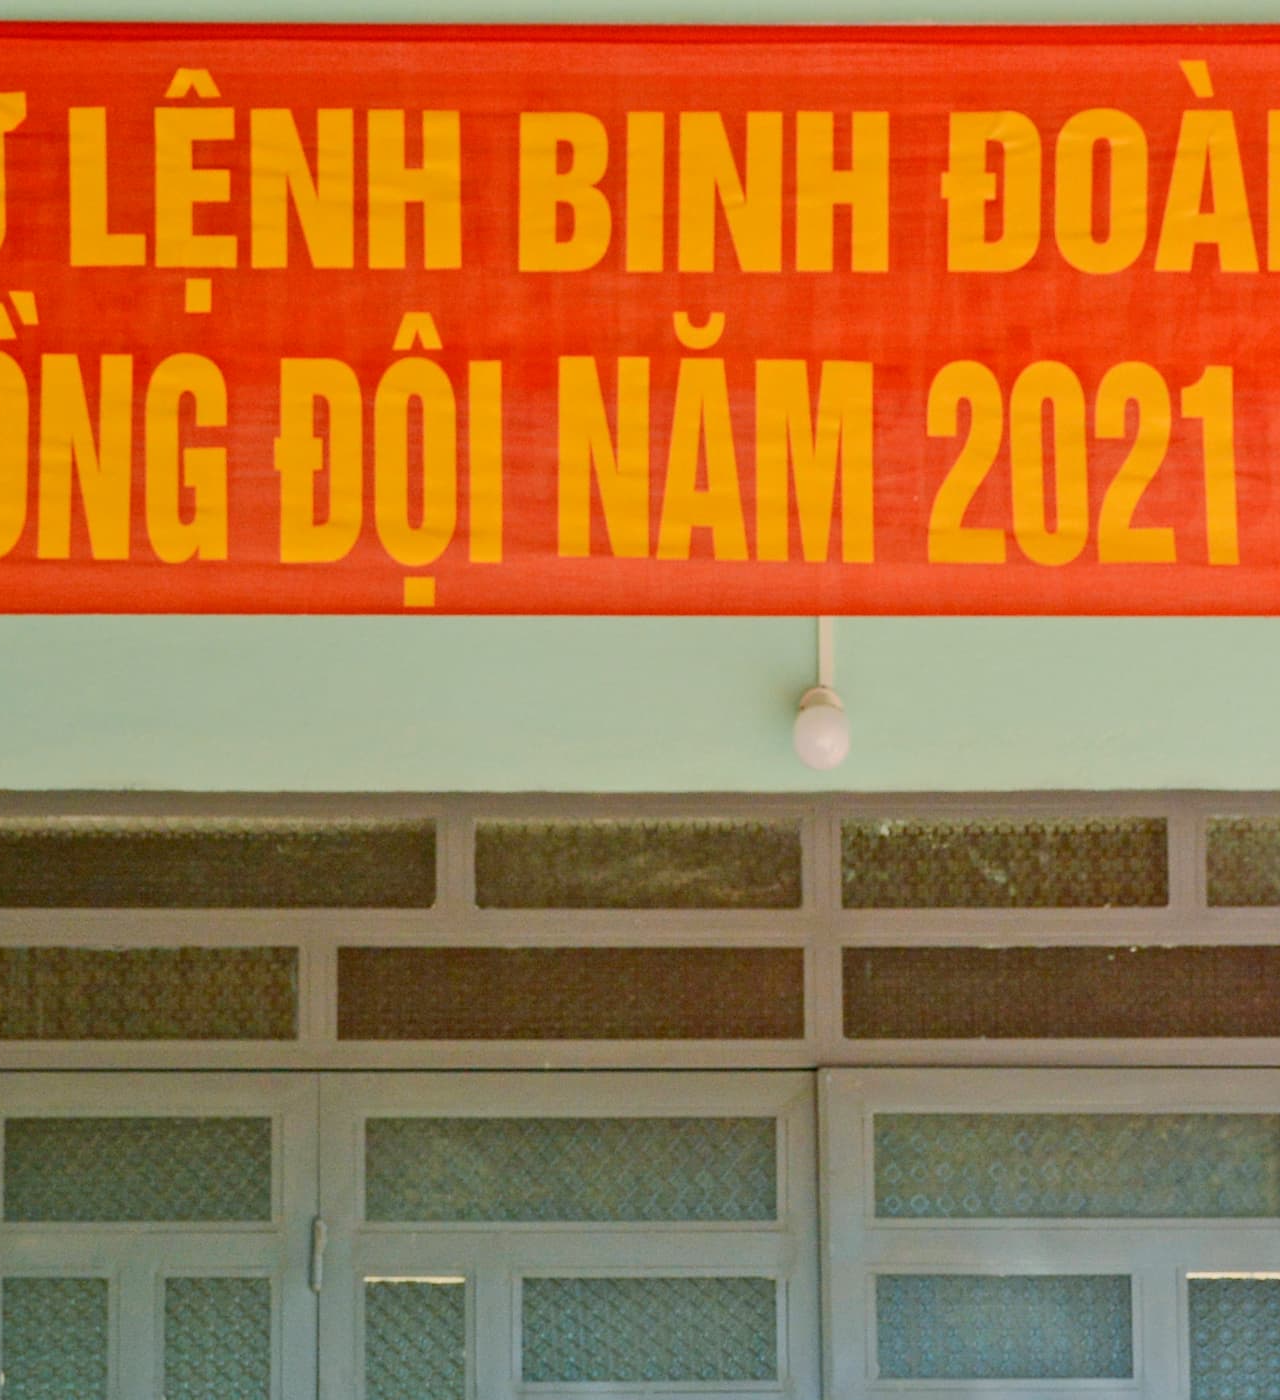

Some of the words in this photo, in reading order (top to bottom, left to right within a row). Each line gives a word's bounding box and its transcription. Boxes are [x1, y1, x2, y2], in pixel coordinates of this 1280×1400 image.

[68, 68, 462, 313] LỆNH
[518, 110, 890, 273] BINH
[273, 311, 504, 608] ĐỘI
[557, 311, 875, 564] NĂM
[926, 360, 1240, 566] 2021
